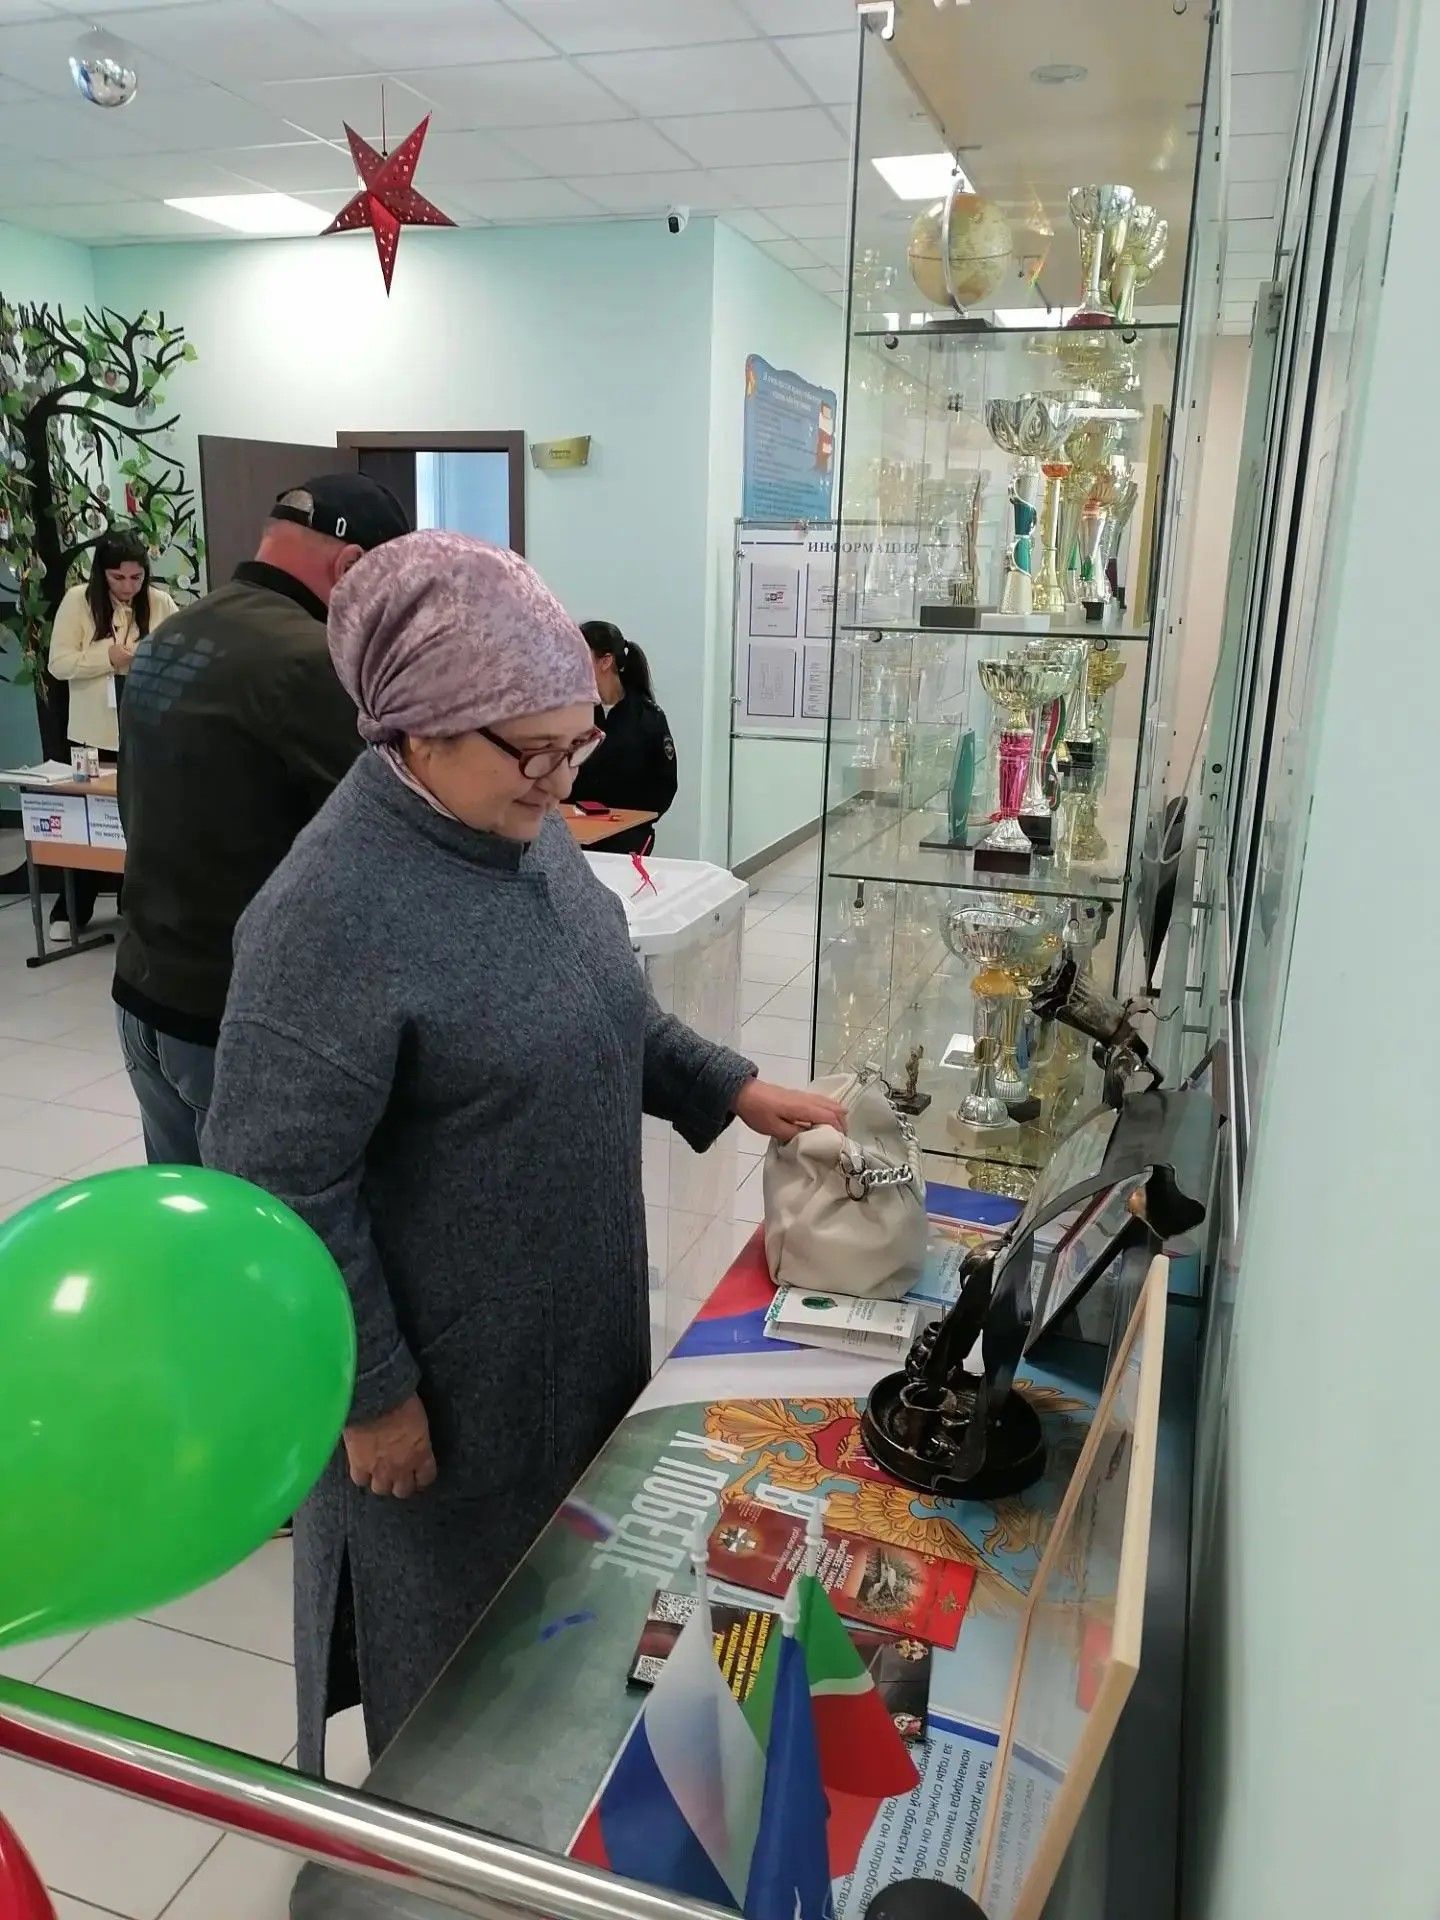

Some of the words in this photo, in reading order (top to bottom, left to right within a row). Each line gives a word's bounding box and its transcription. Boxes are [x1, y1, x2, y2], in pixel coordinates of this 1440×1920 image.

[669, 1430, 744, 1464] К
[590, 1456, 729, 1590] ПОБЕДЕ
[943, 1743, 952, 1755] за
[936, 1756, 950, 1782] годы
[950, 1749, 971, 1808] командира
[978, 1760, 992, 1779] Там
[975, 1780, 985, 1795] он
[925, 1784, 943, 1826] службы
[880, 1823, 890, 1838] он
[896, 1808, 917, 1853] области
[921, 1828, 932, 1845] он
[937, 1810, 957, 1867] танкового
[959, 1795, 981, 1864] дослужился
[894, 1855, 903, 1864] и
[956, 1865, 967, 1882] до
[859, 1840, 886, 1914] попробовал
